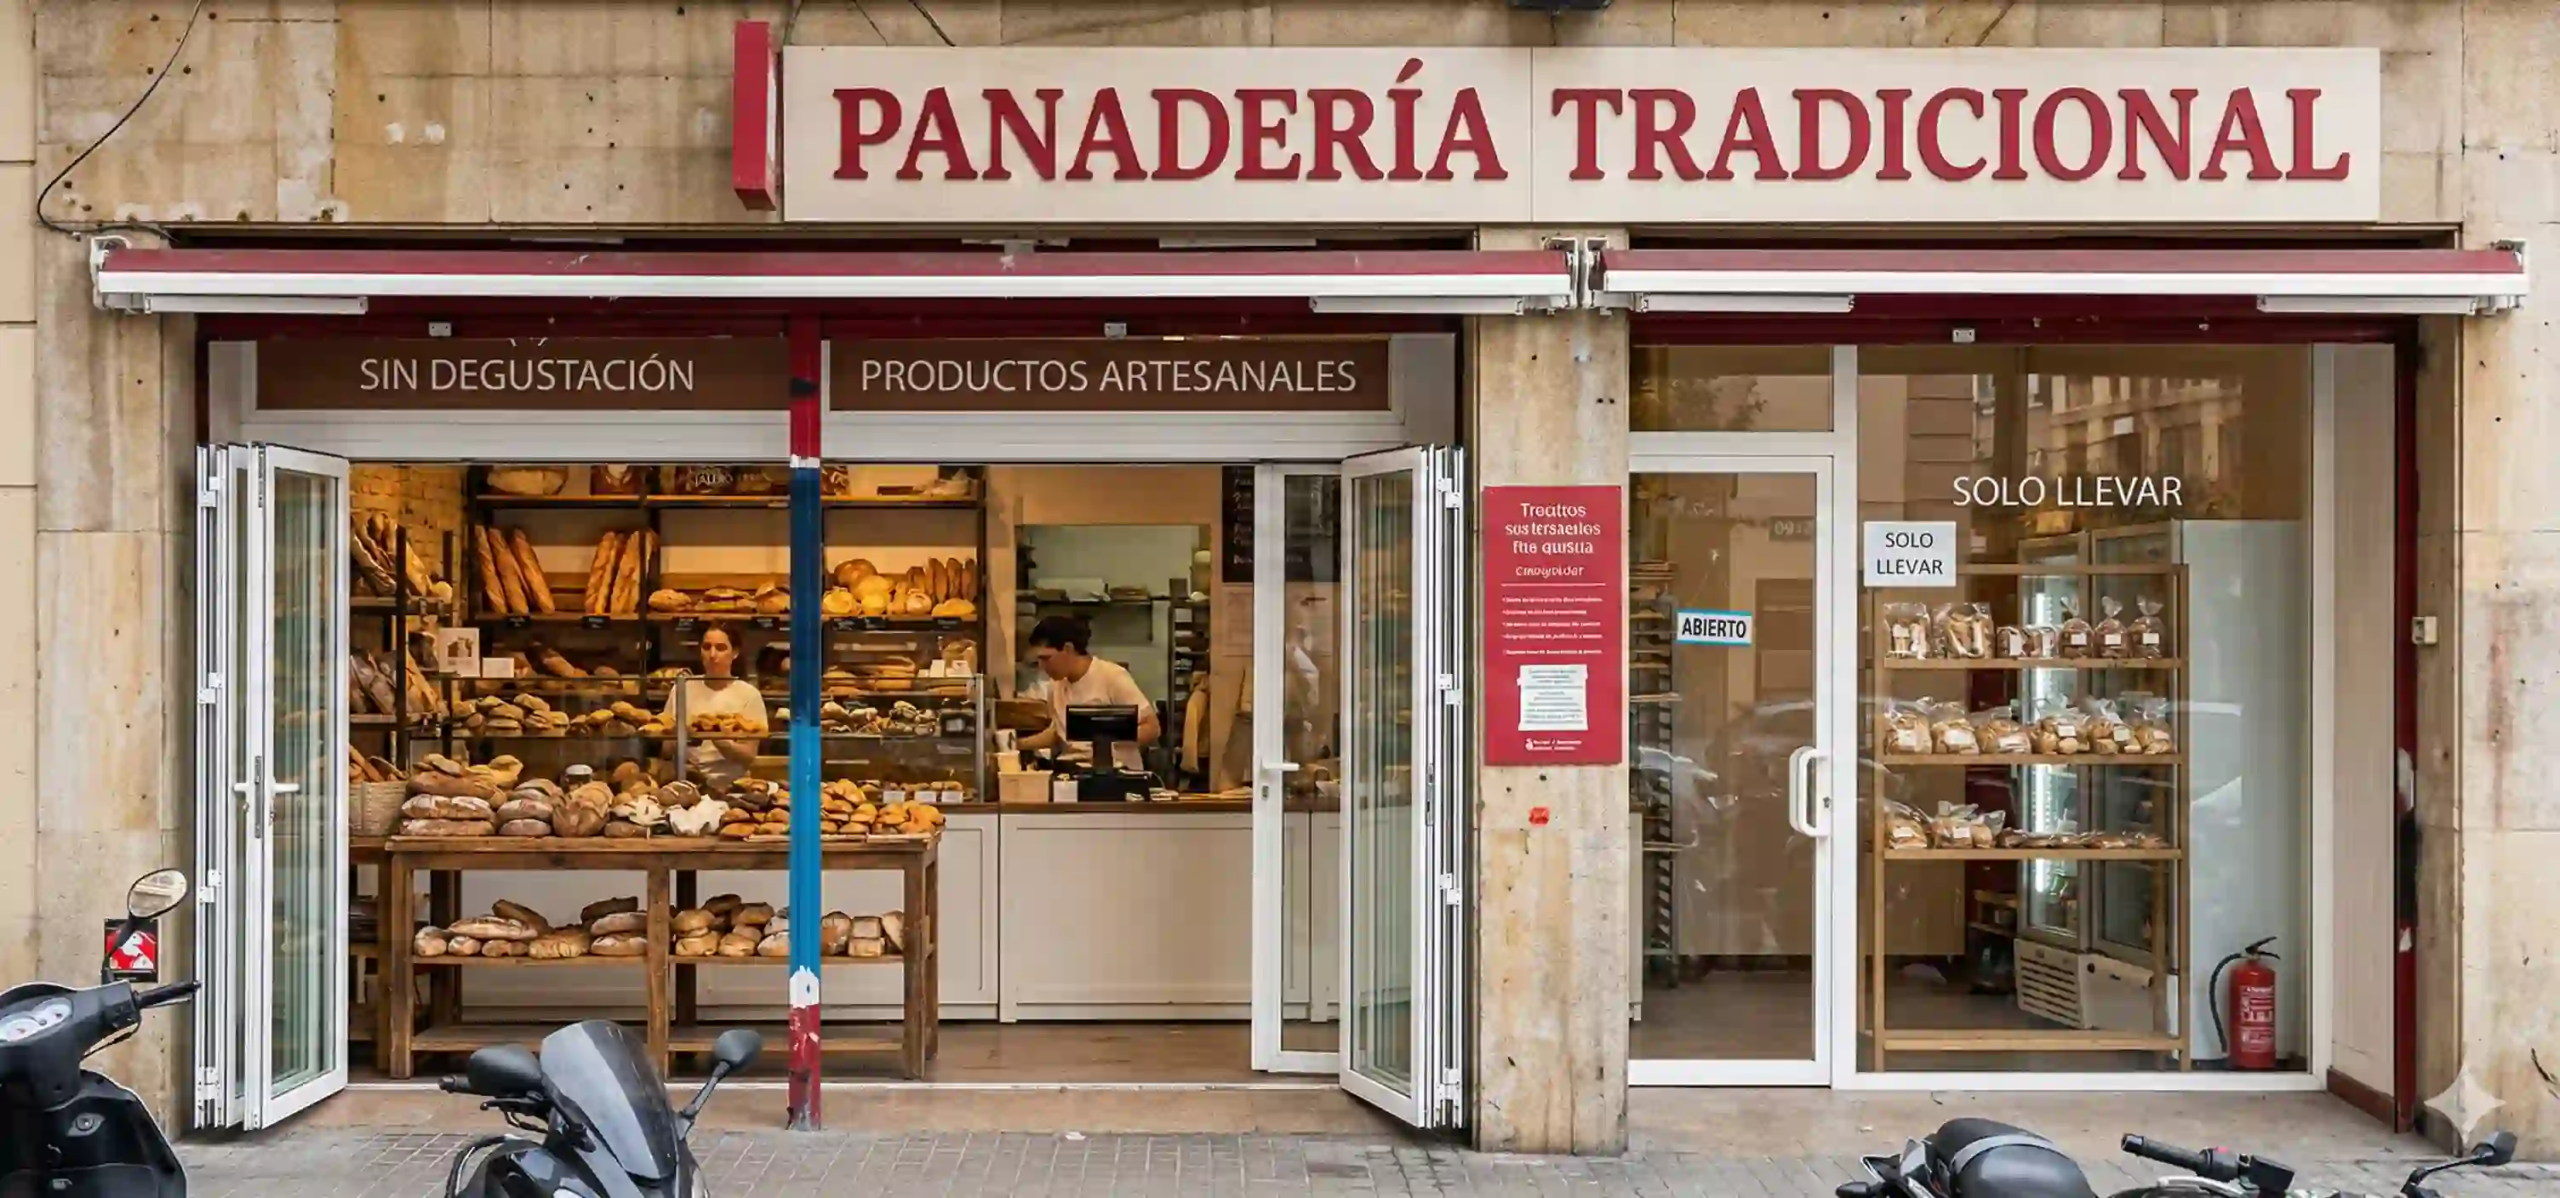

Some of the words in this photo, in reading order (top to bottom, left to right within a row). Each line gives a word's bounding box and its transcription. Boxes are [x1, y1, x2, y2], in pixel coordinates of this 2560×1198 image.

[833, 58, 1509, 181] PANADERÍA
[1551, 87, 2350, 181] TRADICIONAL
[360, 358, 417, 391] SIN
[431, 353, 694, 391] DEGUSTACIÓN
[862, 360, 1088, 392] PRODUCTOS
[1099, 360, 1356, 392] ARTESANALES
[1953, 476, 2045, 506] SOLO
[2057, 476, 2182, 506] LLEVAR
[1885, 532, 1934, 549] SOLO
[1877, 559, 1943, 575] LLEVAR
[1681, 617, 1747, 640] ABIERTO
